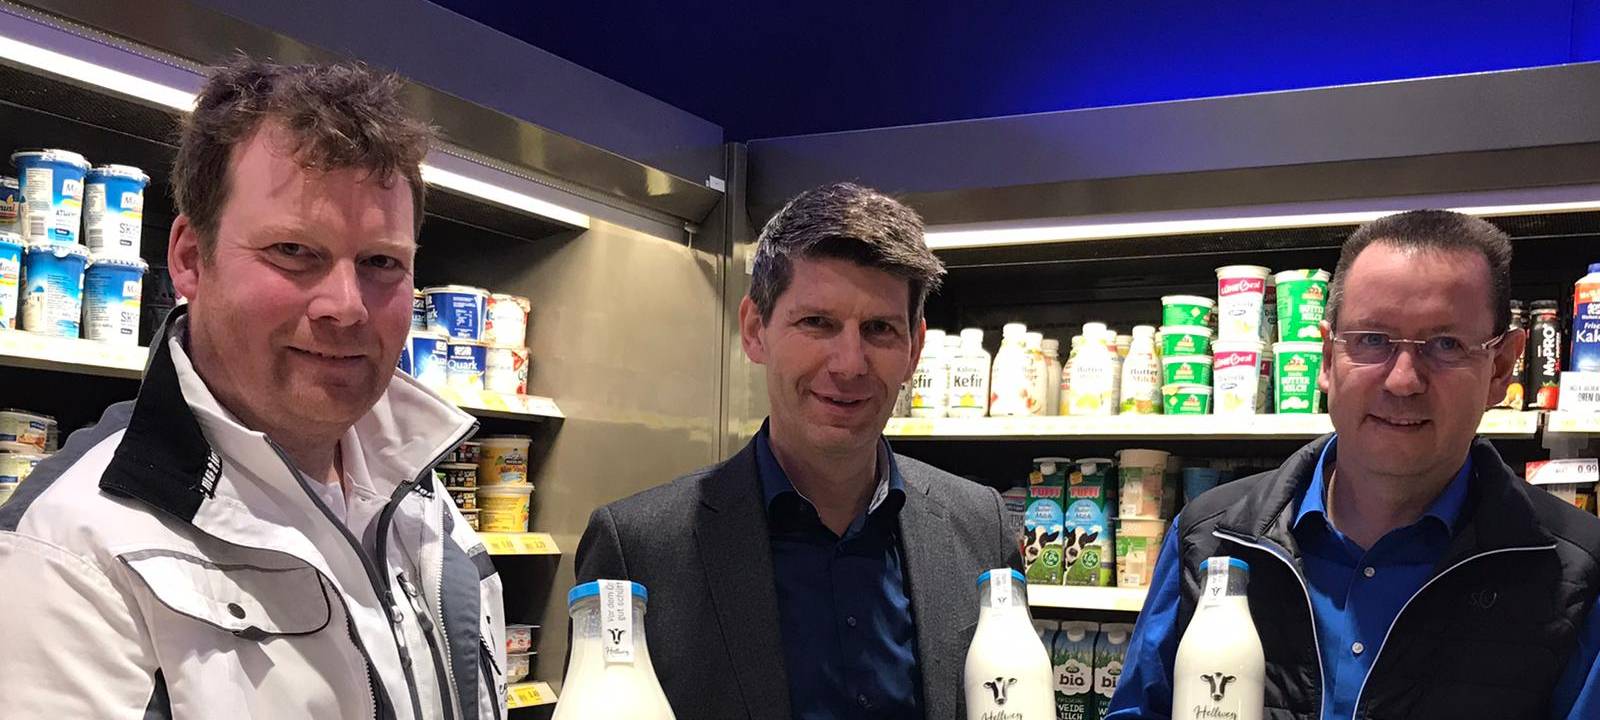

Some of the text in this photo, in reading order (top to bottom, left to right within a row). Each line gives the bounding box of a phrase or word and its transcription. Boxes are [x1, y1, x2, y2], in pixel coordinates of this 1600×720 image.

[1576, 330, 1600, 344] Kak
[448, 359, 478, 370] Quark
[912, 374, 932, 388] efir
[615, 582, 625, 605] schütt
[1059, 673, 1085, 686] bio
[1101, 676, 1117, 688] bi
[1193, 704, 1238, 720] Hellweg
